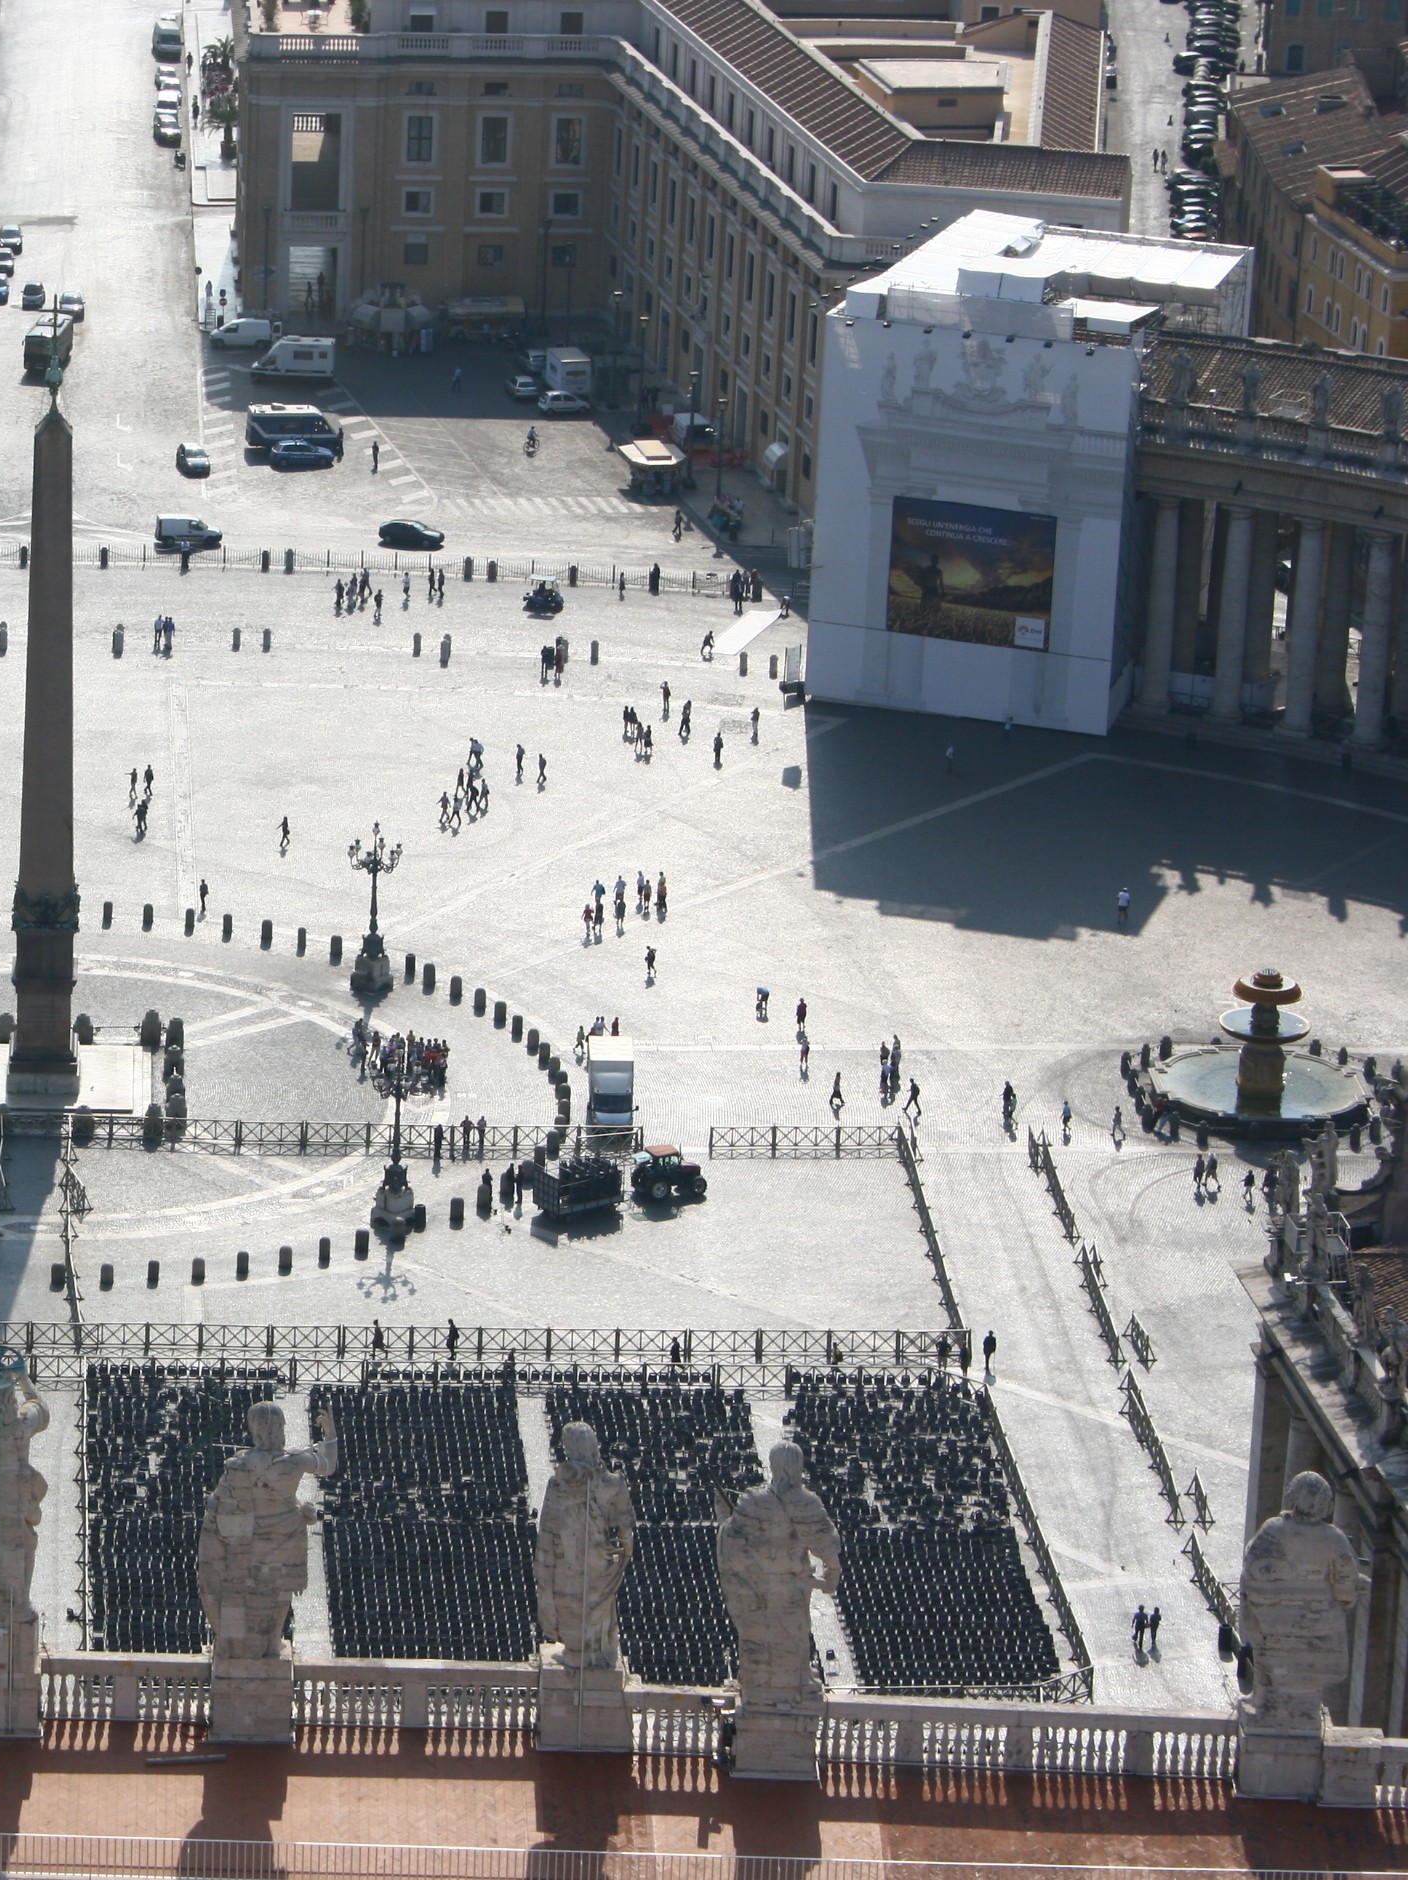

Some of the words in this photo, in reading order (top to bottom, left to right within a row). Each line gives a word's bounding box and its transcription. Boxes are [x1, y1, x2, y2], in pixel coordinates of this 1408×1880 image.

[907, 517, 931, 527] SCEGLI
[978, 526, 993, 535] CHE
[925, 528, 964, 540] CONTINUA
